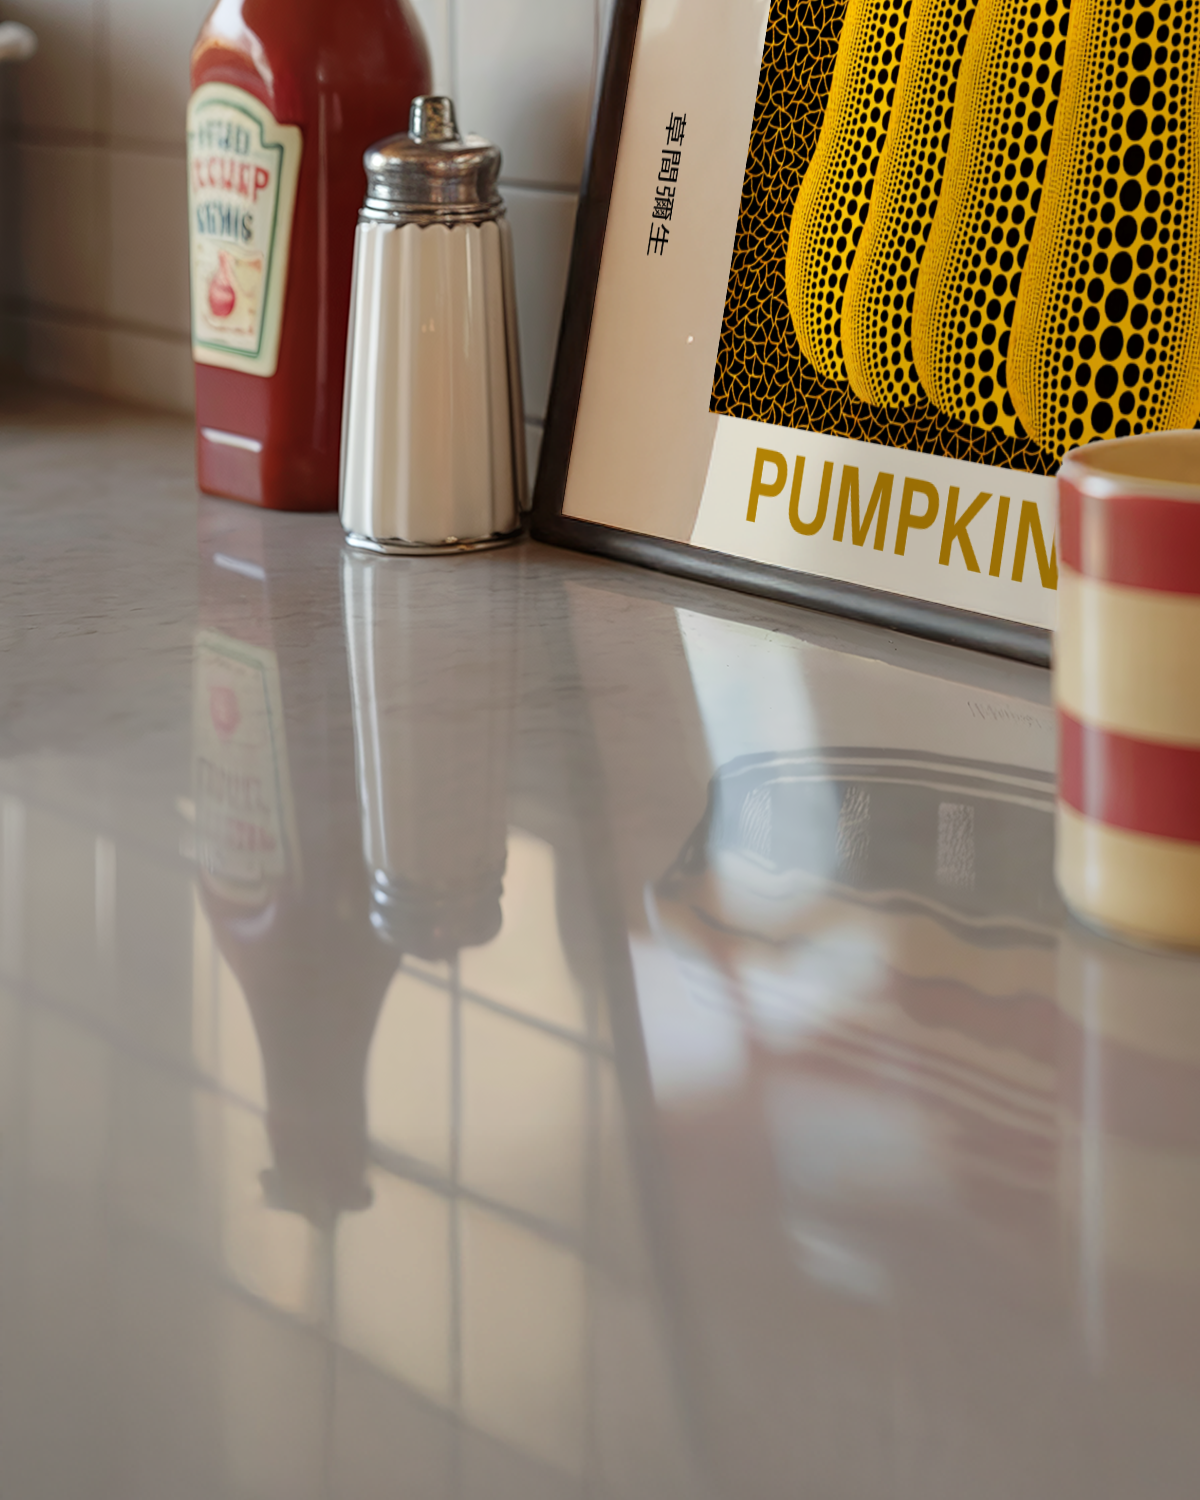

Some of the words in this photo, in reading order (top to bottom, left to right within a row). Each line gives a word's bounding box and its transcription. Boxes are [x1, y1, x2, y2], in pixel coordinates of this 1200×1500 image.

[646, 111, 687, 256] 草間彌生
[745, 446, 1058, 591] PUMPKIN
